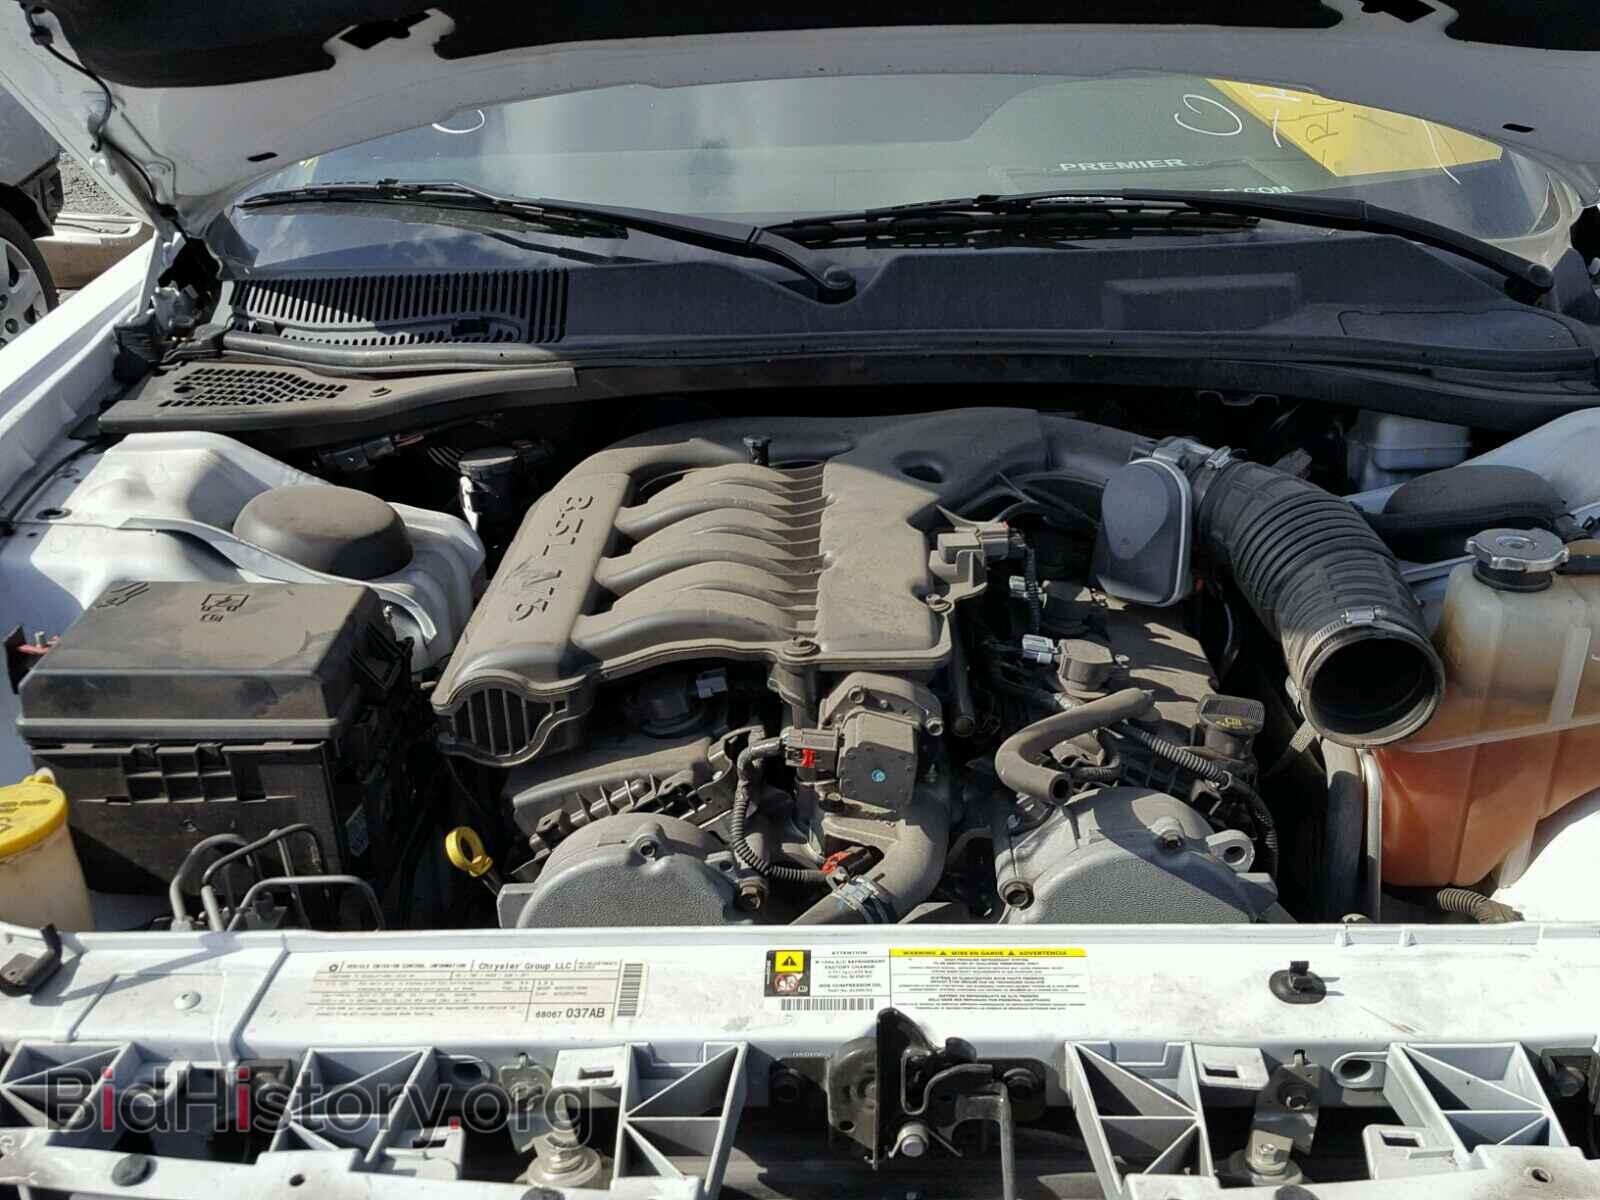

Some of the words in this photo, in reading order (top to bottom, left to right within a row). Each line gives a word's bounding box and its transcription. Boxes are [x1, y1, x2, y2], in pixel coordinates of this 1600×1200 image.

[1059, 158, 1188, 171] PREMIER
[478, 962, 520, 972] Chrysler
[524, 962, 551, 972] Group
[555, 962, 573, 970] LLC
[566, 1007, 606, 1018] 037AB
